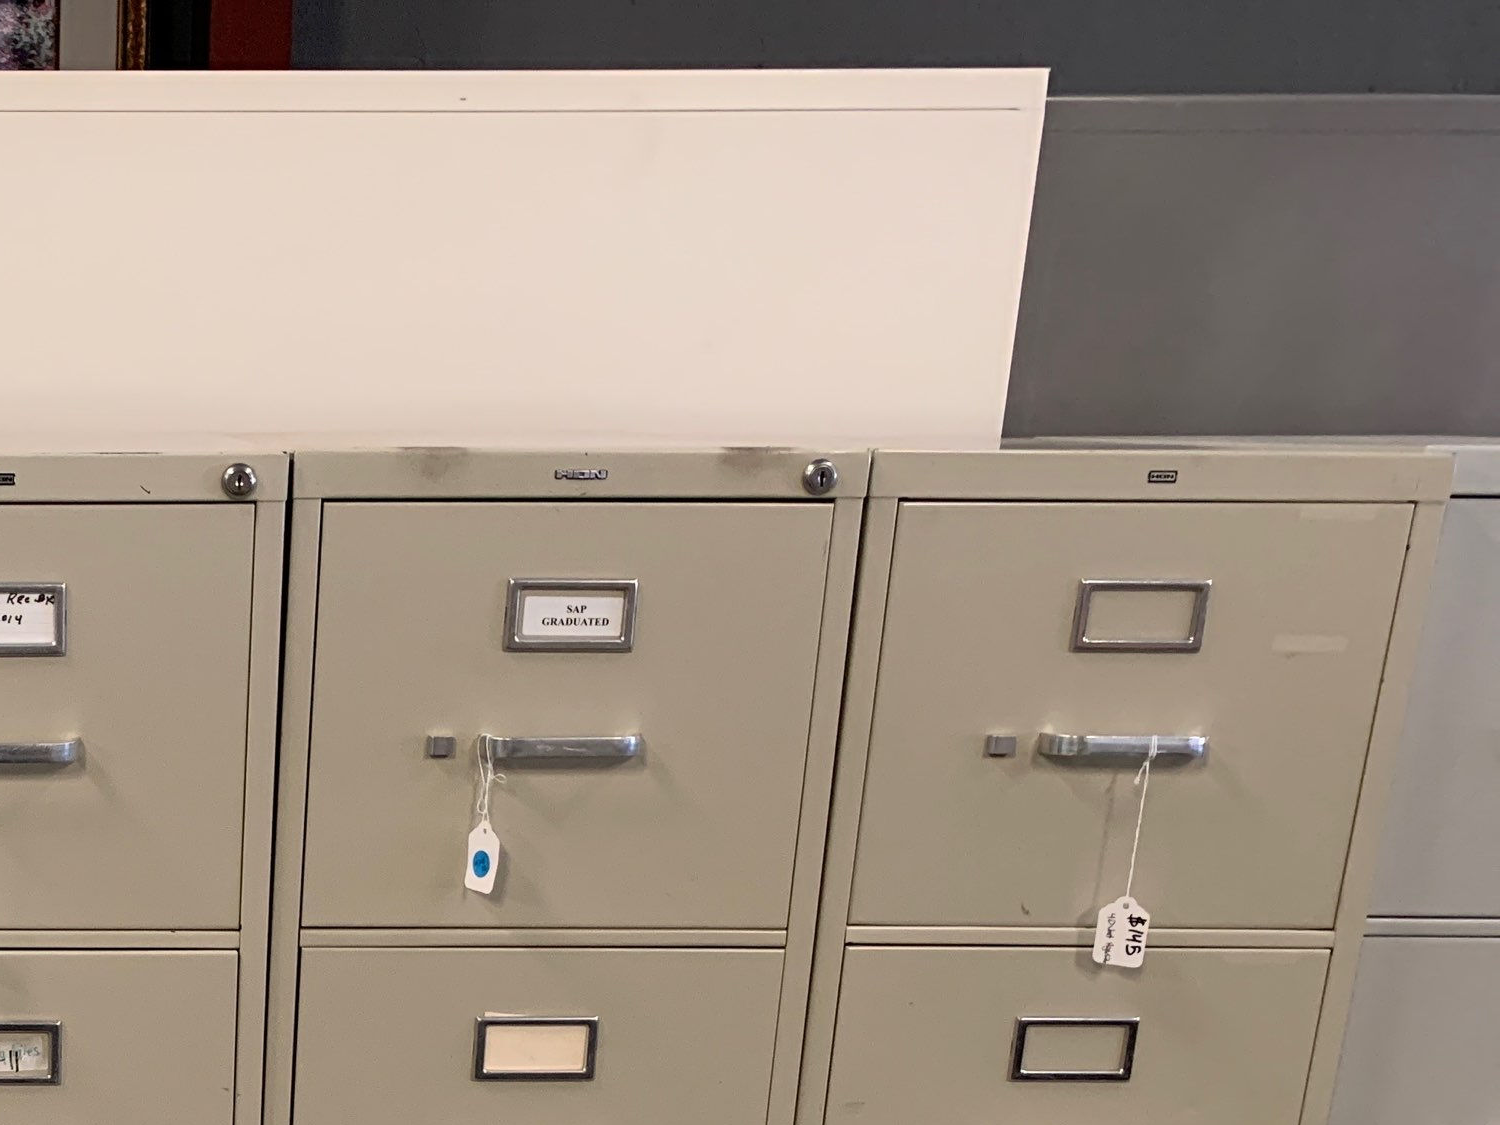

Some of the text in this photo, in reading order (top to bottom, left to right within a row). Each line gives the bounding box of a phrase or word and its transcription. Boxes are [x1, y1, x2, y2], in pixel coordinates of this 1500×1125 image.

[554, 469, 608, 480] HON
[566, 605, 587, 614] SAP
[541, 617, 609, 627] GRADUATED
[1126, 913, 1148, 956] $145
